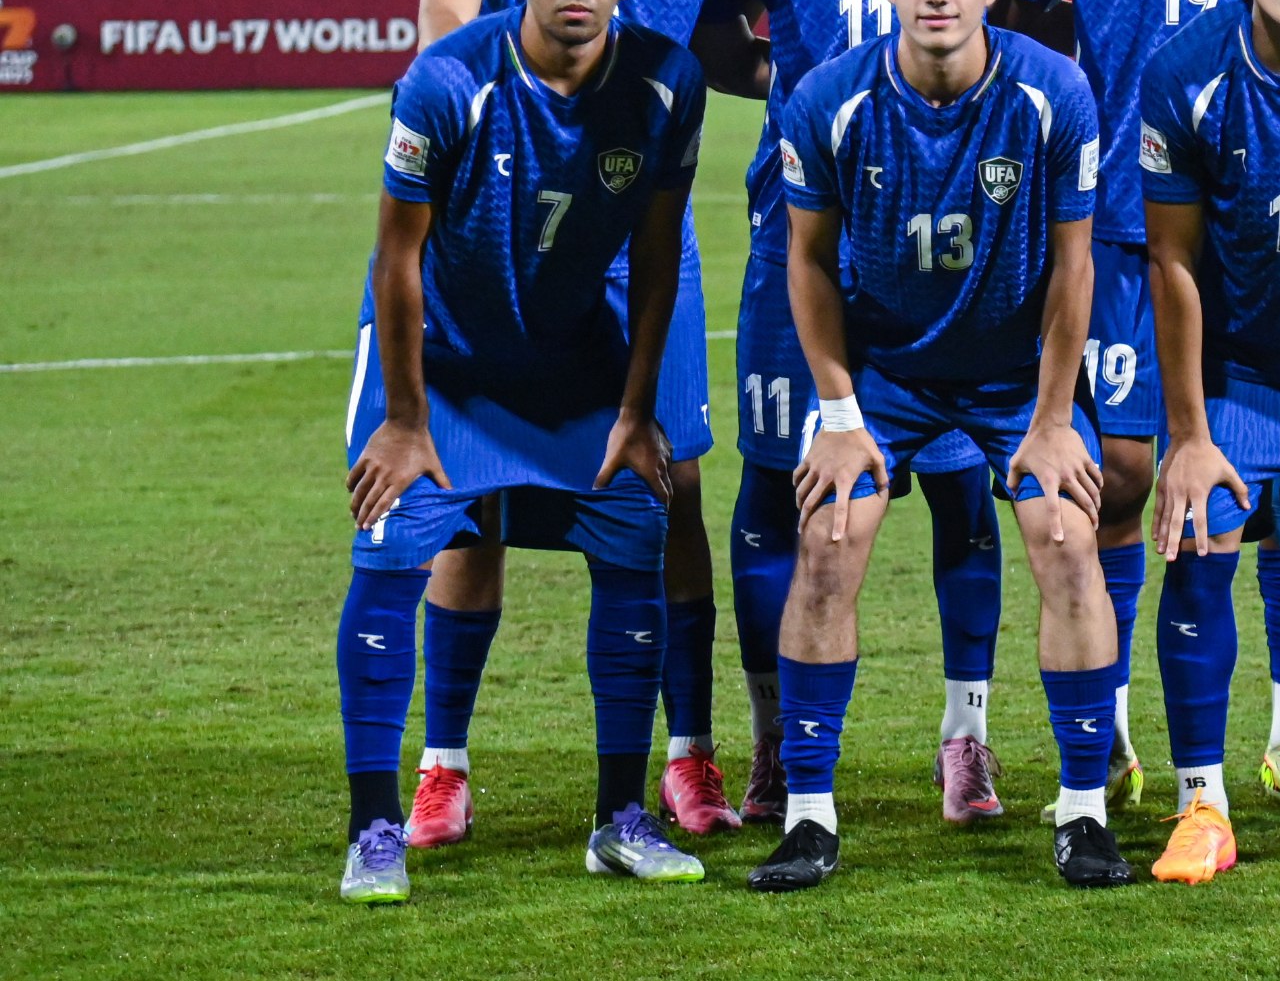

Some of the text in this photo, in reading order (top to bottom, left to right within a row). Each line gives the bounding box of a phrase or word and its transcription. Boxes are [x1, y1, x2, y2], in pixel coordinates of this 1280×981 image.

[101, 19, 416, 53] FIFA U-17 WORLD
[604, 157, 634, 172] UFA
[985, 166, 1016, 183] UFA
[537, 190, 573, 252] 7
[907, 213, 974, 272] 13
[1083, 338, 1137, 406] 19
[745, 373, 790, 439] 11
[757, 684, 778, 700] 11
[967, 691, 983, 708] 11
[1184, 776, 1206, 789] 16
